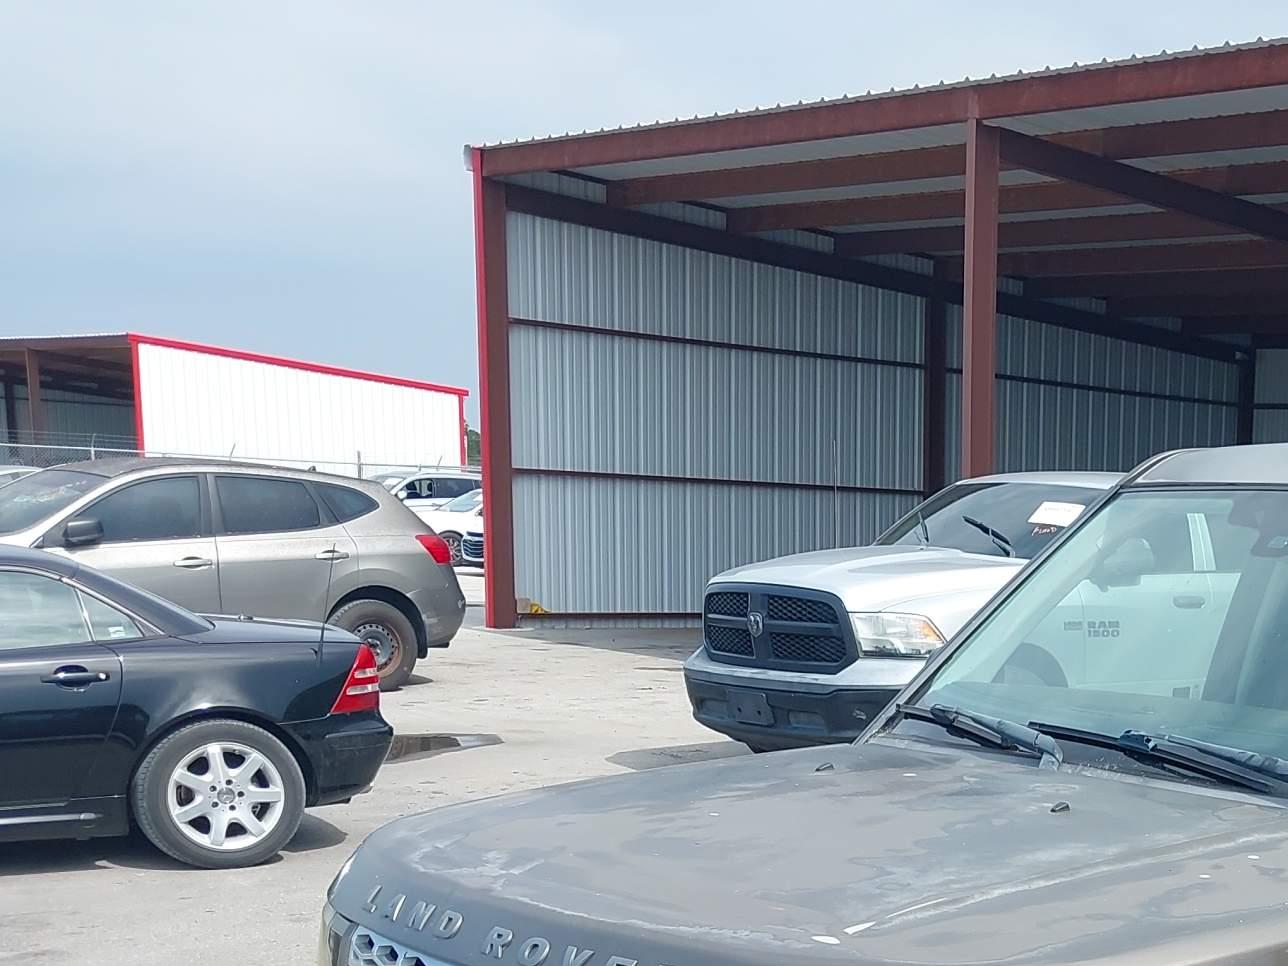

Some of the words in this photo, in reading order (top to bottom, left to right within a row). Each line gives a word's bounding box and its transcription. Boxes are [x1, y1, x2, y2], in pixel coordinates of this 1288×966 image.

[1087, 620, 1121, 629] RAM
[1087, 629, 1121, 638] 1500
[365, 884, 464, 939] LAND
